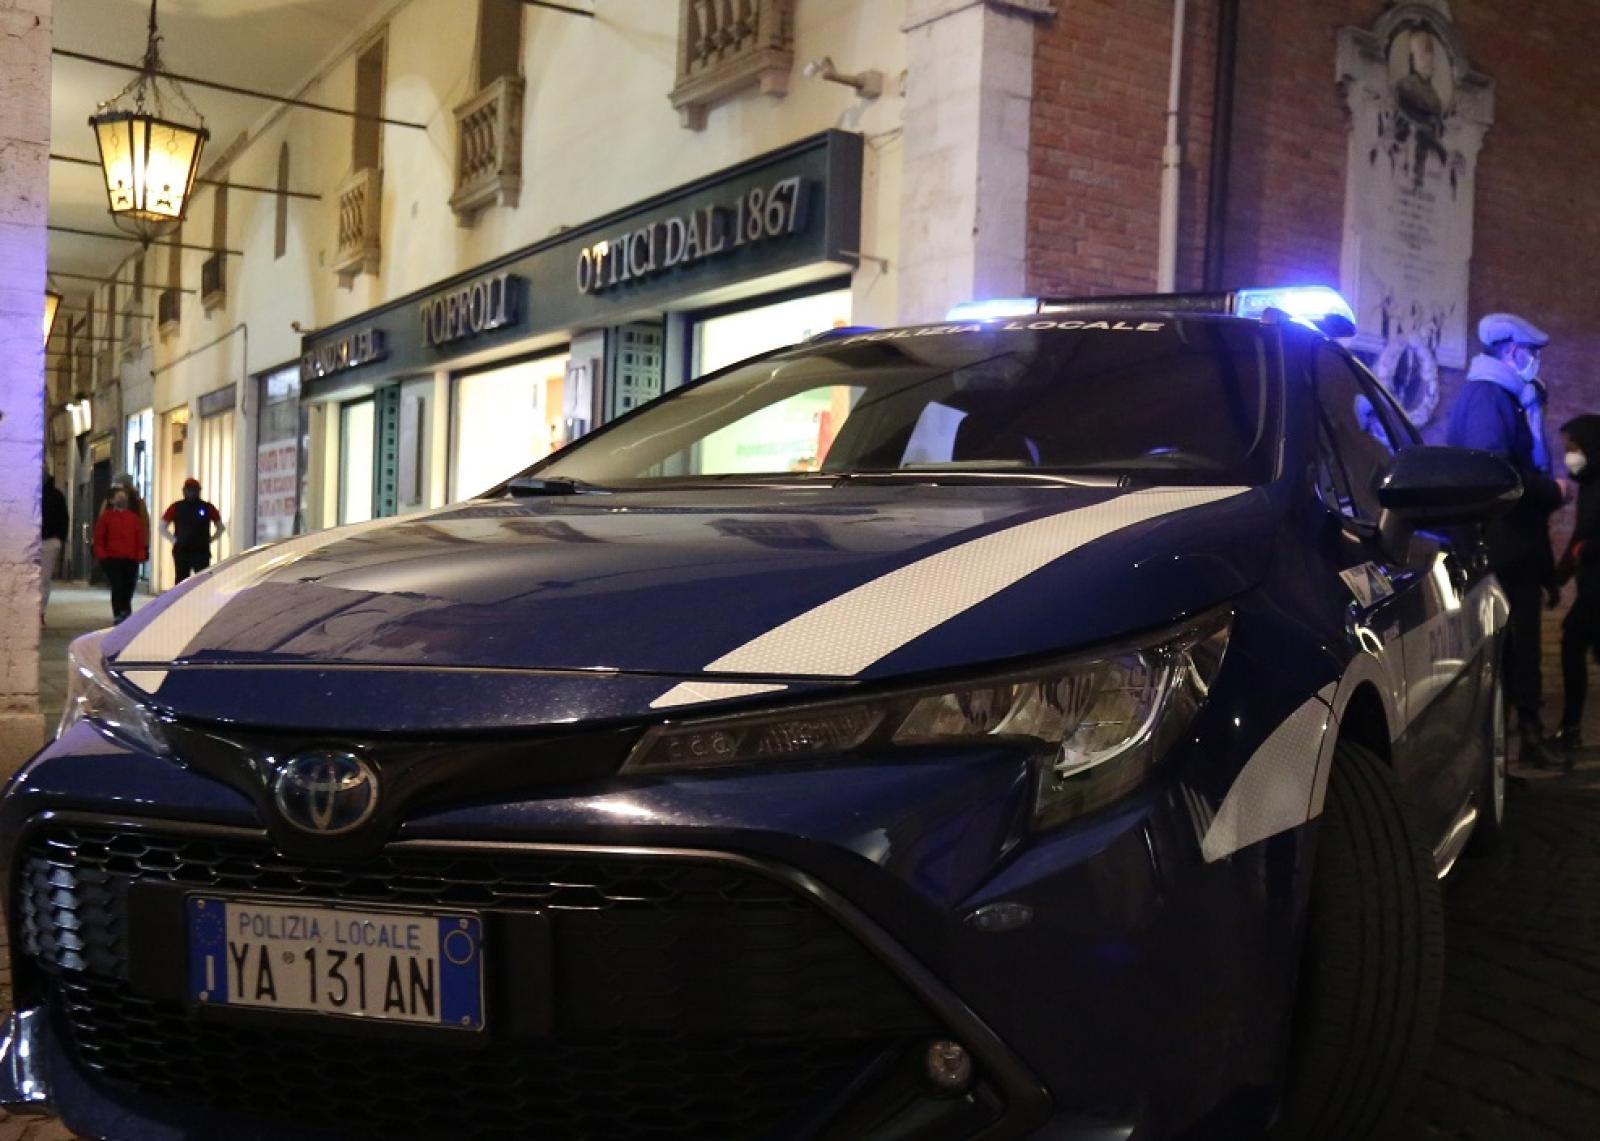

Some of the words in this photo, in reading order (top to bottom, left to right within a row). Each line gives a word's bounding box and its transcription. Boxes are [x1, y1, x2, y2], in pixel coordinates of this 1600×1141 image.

[577, 223, 657, 295] OTTICI
[664, 203, 724, 267] DAL
[735, 176, 800, 246] 1867
[419, 271, 508, 347] TOFFOLI
[1003, 320, 1165, 332] LOCALE
[239, 912, 320, 941] POLIZIA
[335, 922, 422, 950] LOCALE
[229, 941, 277, 1001] YA
[304, 947, 367, 1009] 131
[384, 955, 435, 1016] AN
